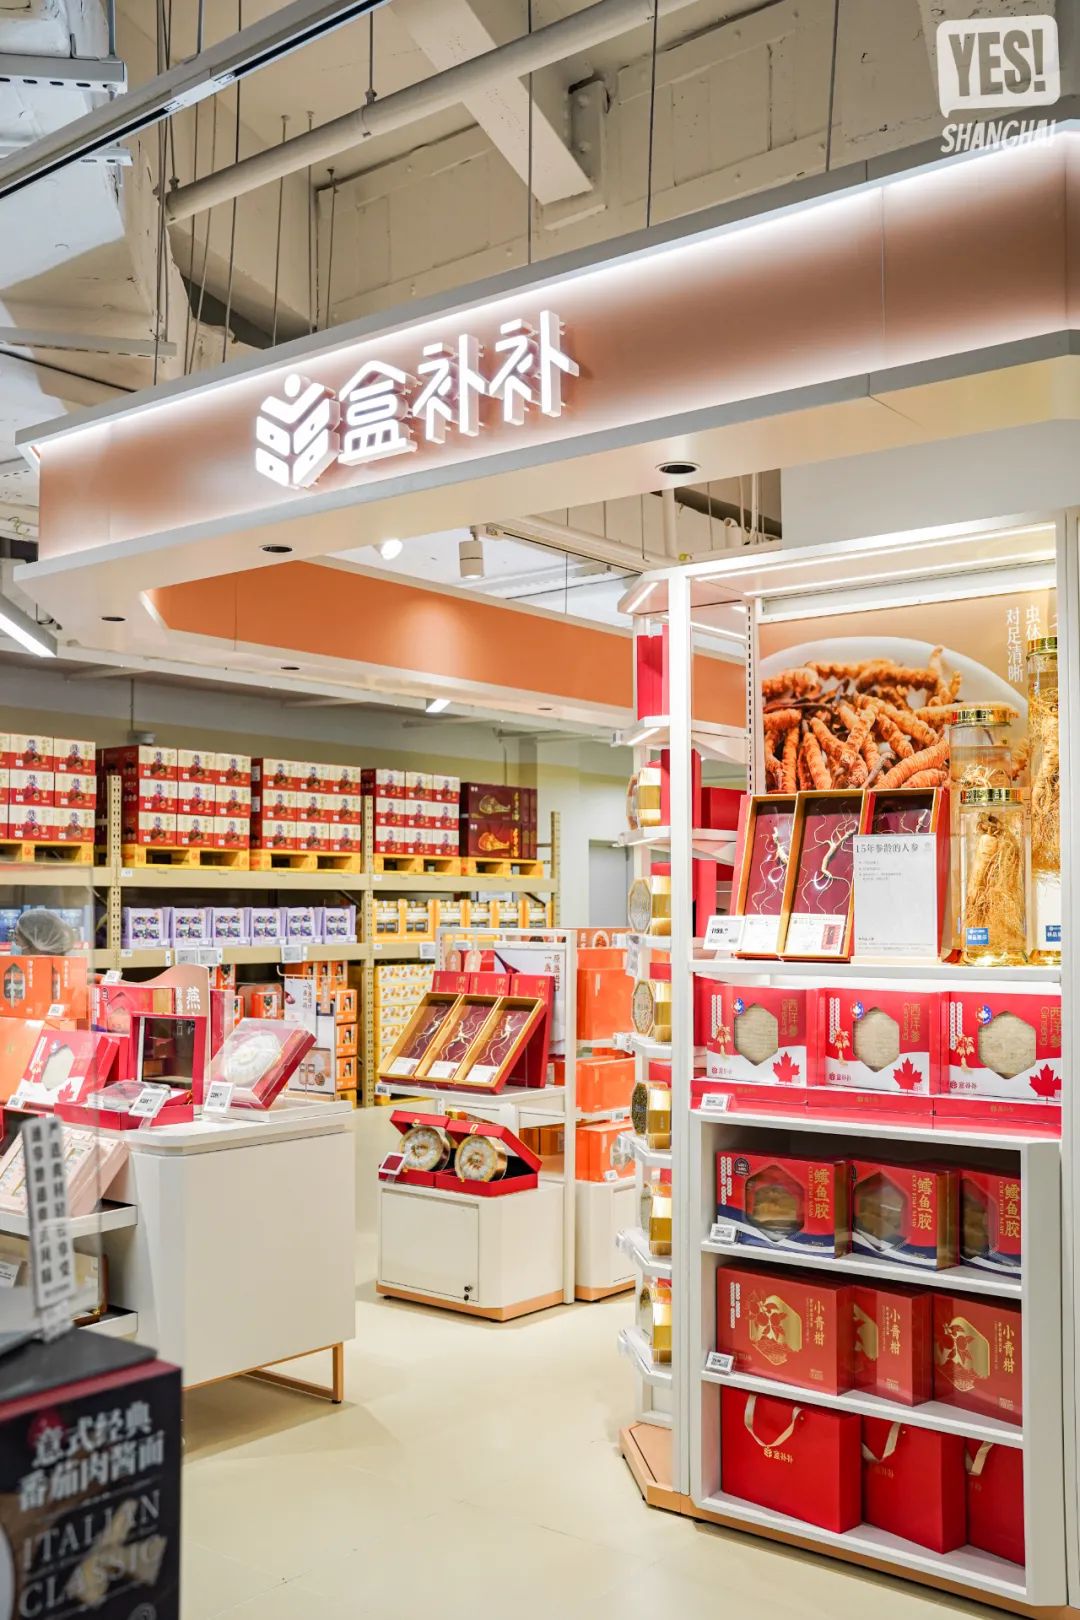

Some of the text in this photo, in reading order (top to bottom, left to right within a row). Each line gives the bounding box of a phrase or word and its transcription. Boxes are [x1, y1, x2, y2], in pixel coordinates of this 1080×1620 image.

[338, 310, 578, 466] 盒补补
[32, 1400, 152, 1468] 意式经典
[23, 1489, 160, 1571] ITALIAN
